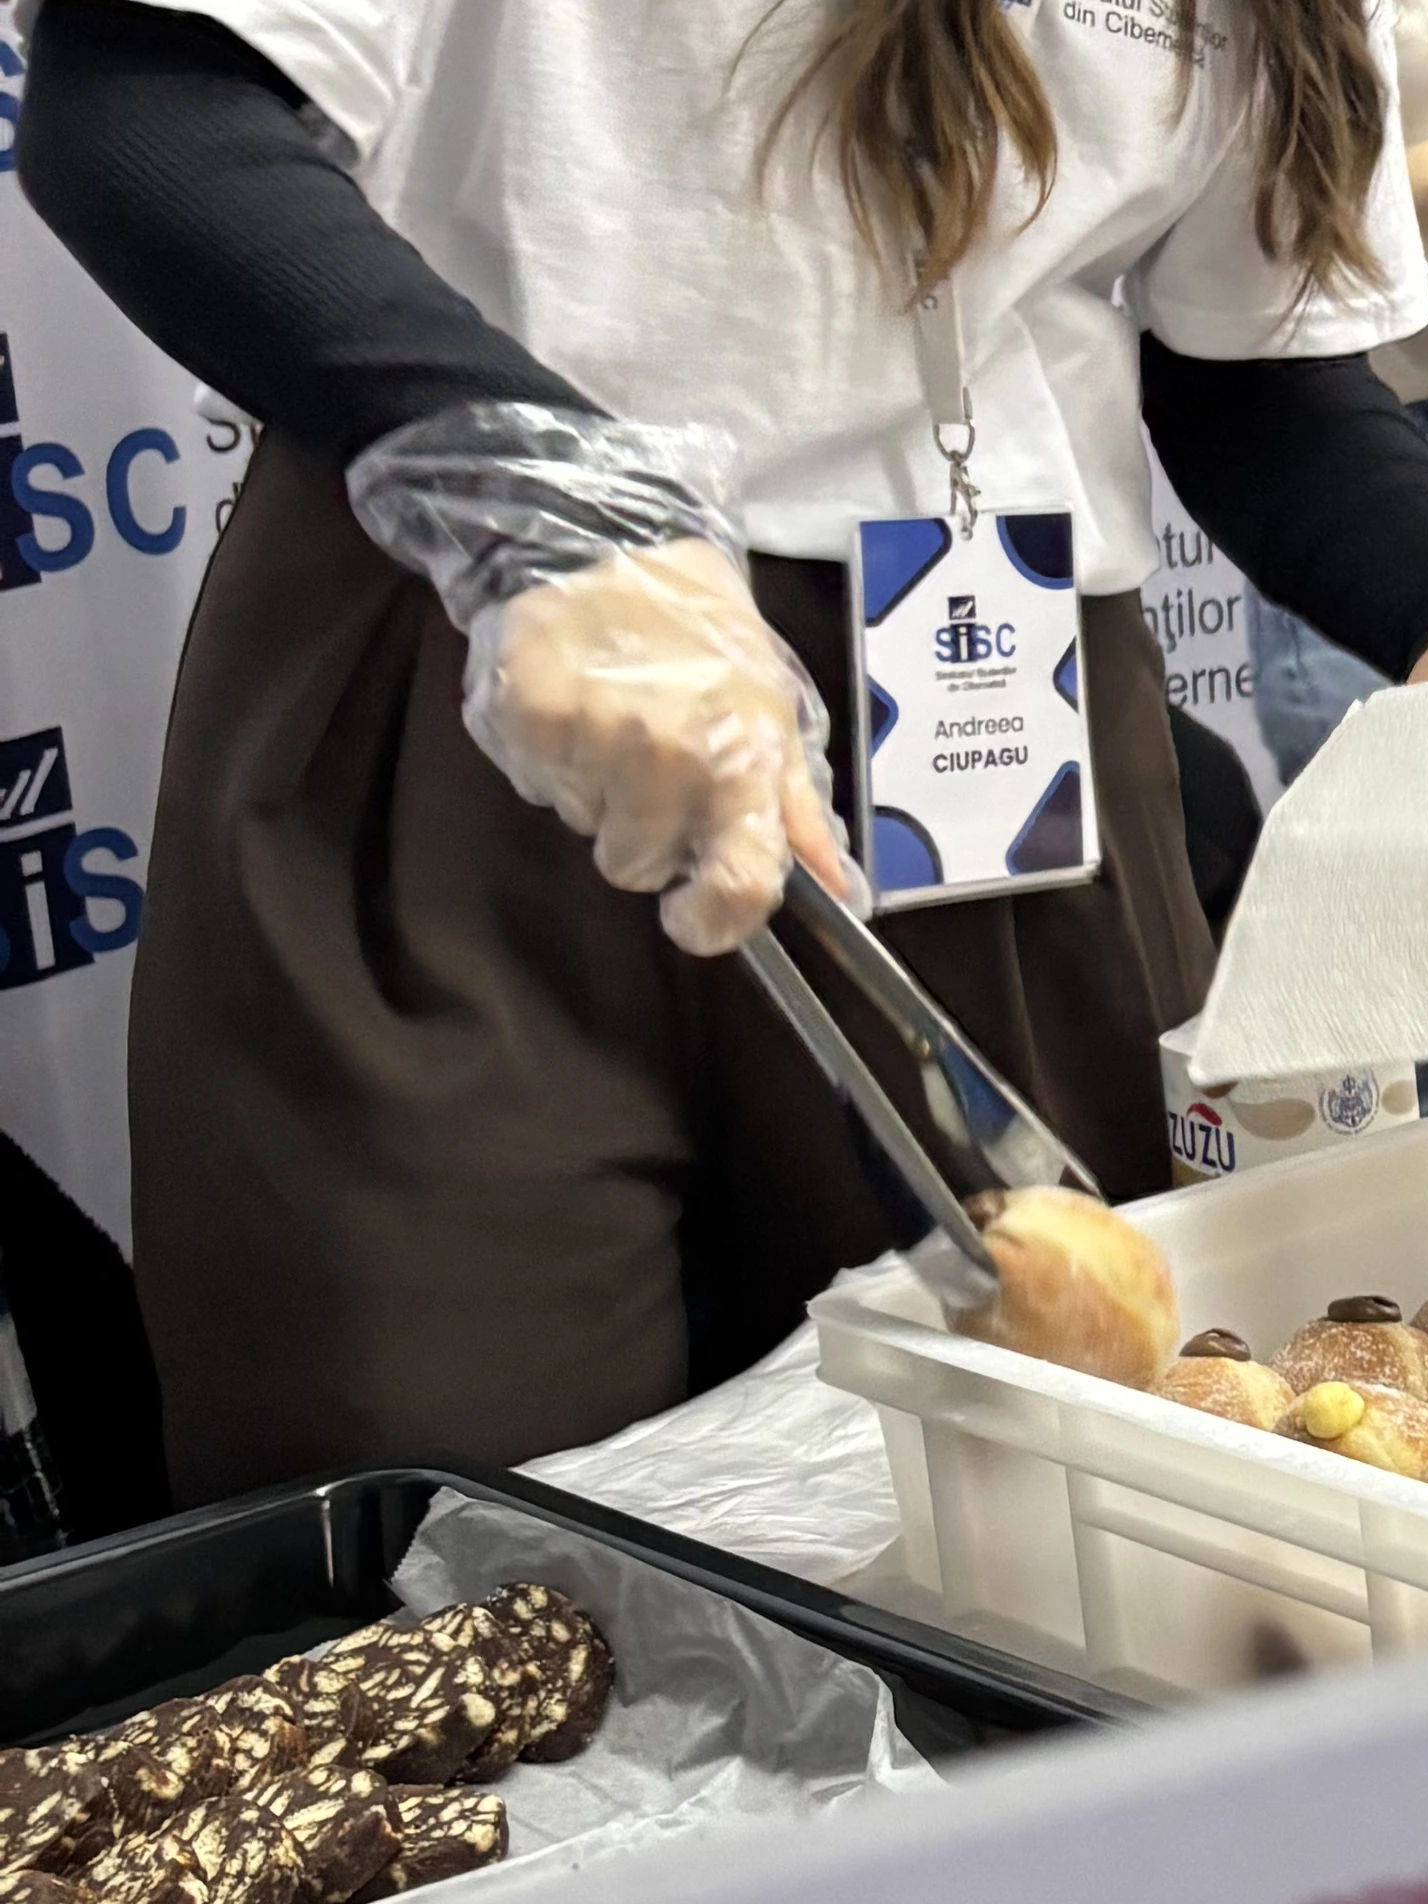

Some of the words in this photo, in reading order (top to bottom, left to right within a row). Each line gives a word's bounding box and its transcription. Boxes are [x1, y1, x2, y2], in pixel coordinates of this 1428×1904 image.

[1063, 0, 1095, 27] din
[934, 713, 1025, 741] Andreea
[932, 745, 1028, 774] CIUPAGU
[1168, 1108, 1236, 1173] ZUZU
